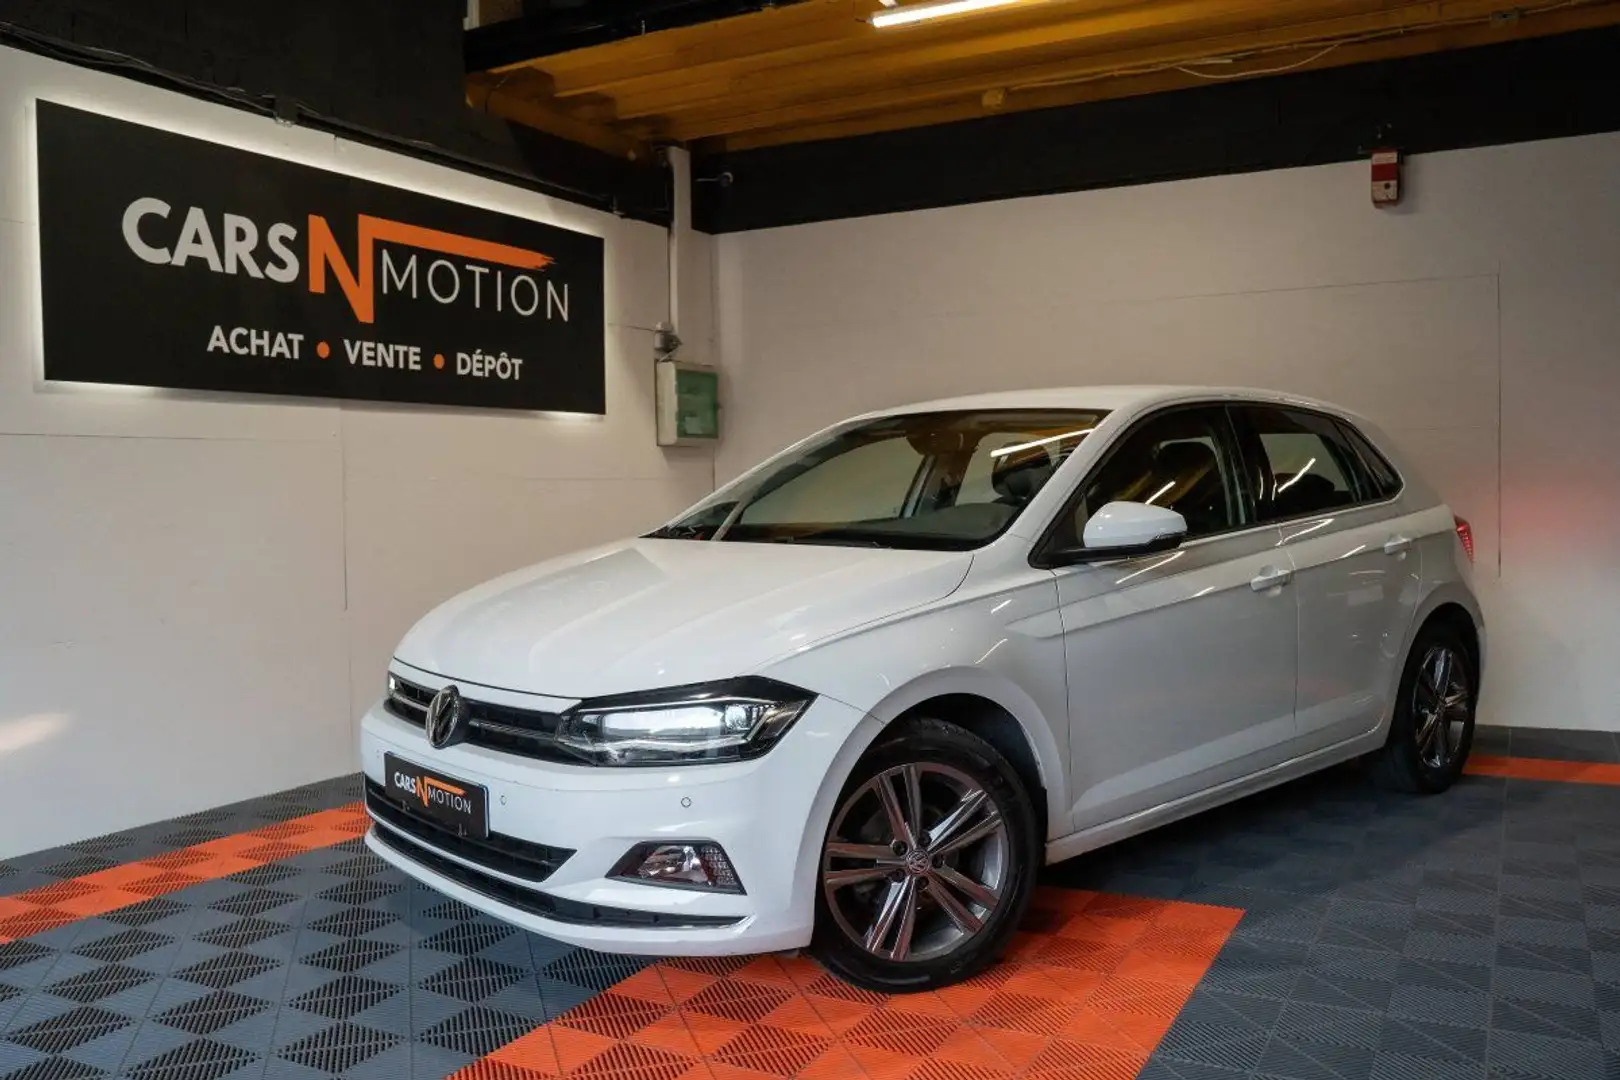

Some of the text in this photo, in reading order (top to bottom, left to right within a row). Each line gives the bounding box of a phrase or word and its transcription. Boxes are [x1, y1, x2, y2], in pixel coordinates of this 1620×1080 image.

[206, 325, 523, 381] ACHAT VENTE DÉPÔT
